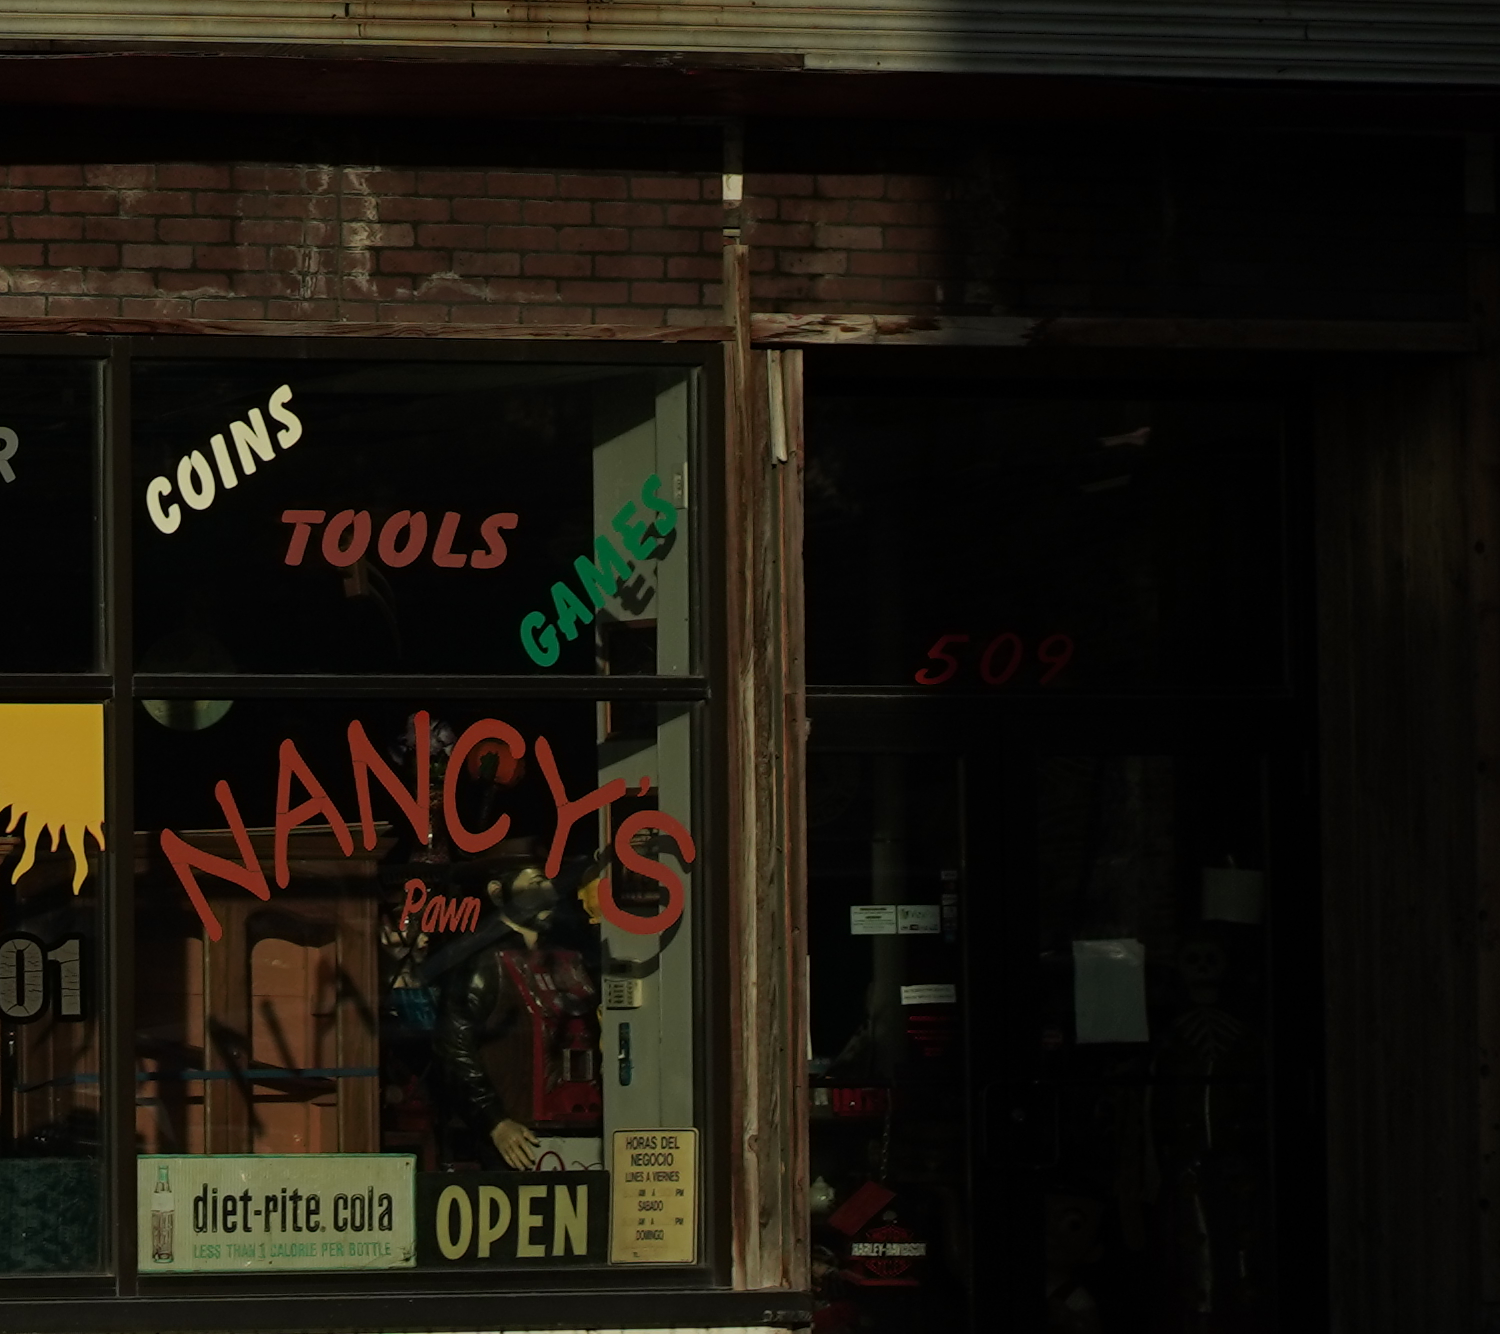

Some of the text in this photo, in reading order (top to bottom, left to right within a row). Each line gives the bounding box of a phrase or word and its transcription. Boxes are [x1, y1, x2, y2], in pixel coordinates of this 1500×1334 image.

[145, 382, 305, 536] COINS
[279, 508, 521, 570] TOOLS
[519, 472, 681, 668] GAMES
[913, 630, 1076, 687] 509
[160, 710, 696, 942] NANCY'S
[399, 878, 482, 934] Pawn
[626, 1136, 681, 1150] HORAS DEL
[631, 1153, 674, 1167] NEGOCIO
[193, 1183, 393, 1233] diet-rite cola
[435, 1183, 590, 1262] OPEN
[194, 1244, 221, 1259] LESS
[227, 1243, 256, 1259] THAN
[269, 1243, 317, 1259] CALORIE
[321, 1242, 344, 1258] PER
[350, 1242, 392, 1257] BOTTLE
